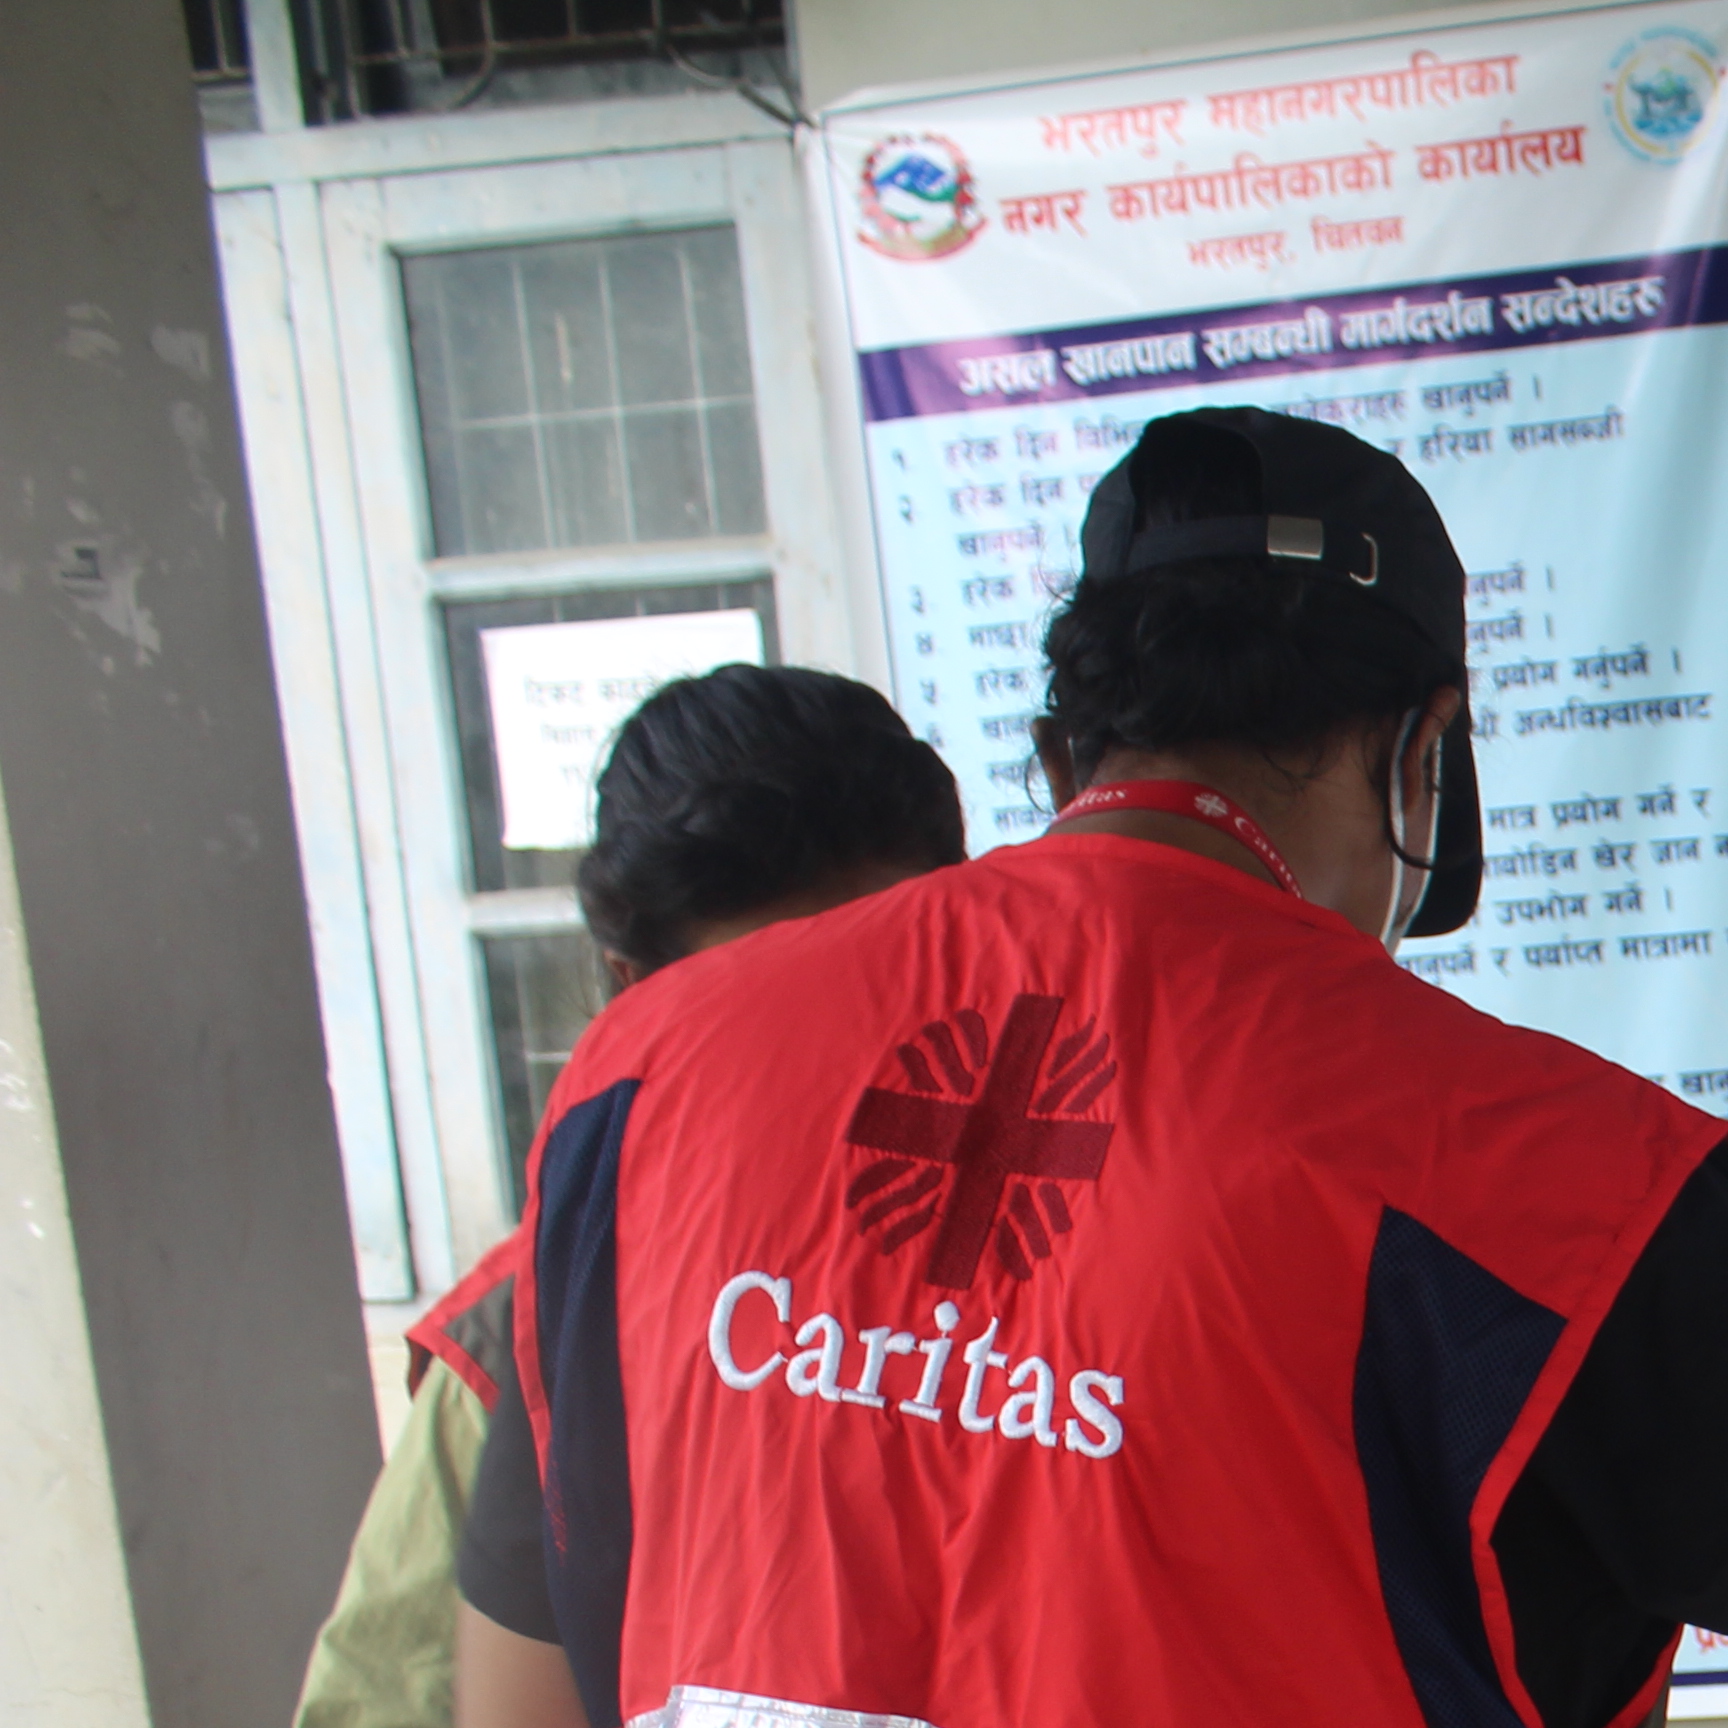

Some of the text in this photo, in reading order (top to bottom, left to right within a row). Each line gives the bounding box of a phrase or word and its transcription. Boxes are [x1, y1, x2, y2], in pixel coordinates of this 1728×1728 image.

[1039, 49, 1523, 159] भरतपुर महानगरपालिका
[1002, 121, 1588, 239] नगर कार्यपालिकाको कार्यालय
[708, 1269, 1124, 1459] Caritas
